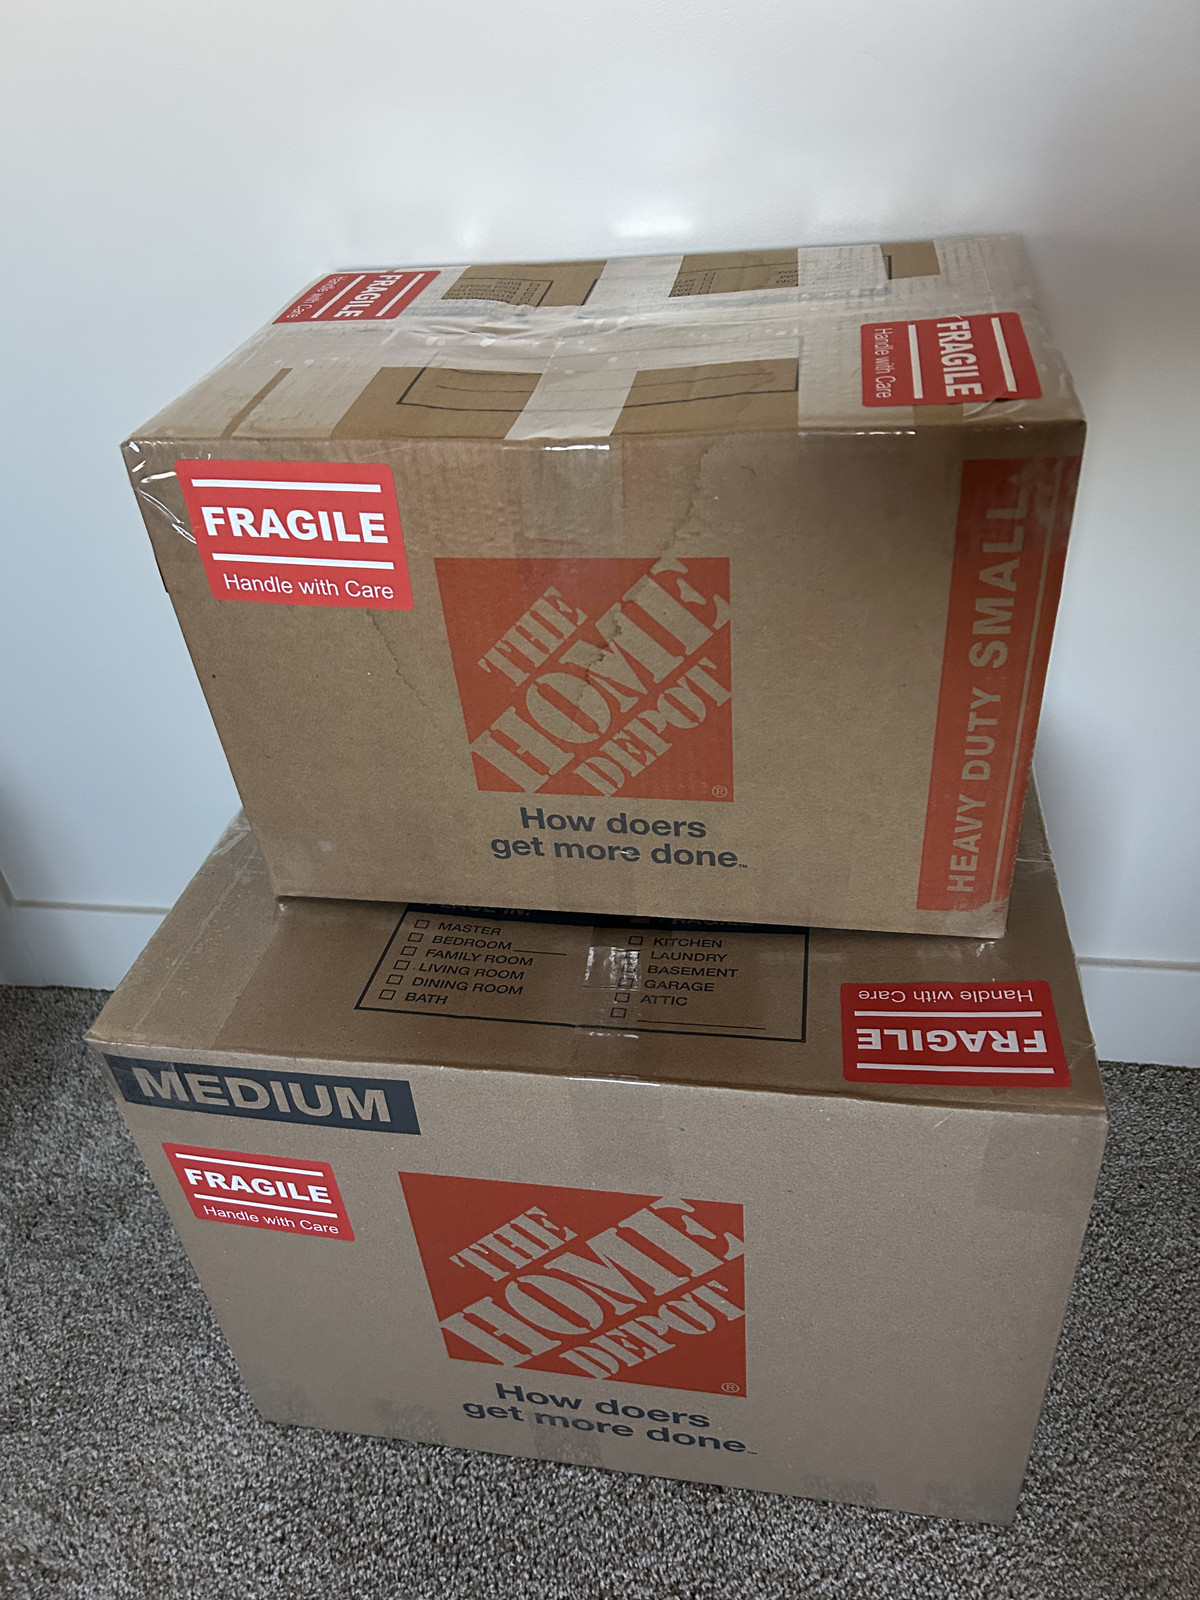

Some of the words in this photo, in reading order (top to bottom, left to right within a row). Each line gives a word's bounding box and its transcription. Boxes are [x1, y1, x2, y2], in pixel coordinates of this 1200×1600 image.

[333, 274, 403, 318] FRAGILE
[286, 303, 313, 318] Care
[874, 327, 894, 356] Handle
[875, 357, 896, 374] with
[936, 320, 983, 397] FRAGILE
[875, 375, 897, 398] Care
[201, 506, 389, 544] FRAGILE
[223, 573, 293, 594] Handle
[298, 578, 339, 597] with
[345, 580, 394, 600] Care
[968, 489, 1029, 669] SMALL
[477, 586, 588, 687] THE
[470, 556, 731, 793] HOME
[573, 658, 732, 797] DEPOT
[961, 687, 1002, 781] DUTY
[519, 806, 596, 832] How
[607, 812, 707, 839] doers
[490, 836, 545, 860] get
[554, 842, 641, 862] more
[946, 794, 987, 894] HEAVY
[432, 935, 512, 950] BEDROOM
[438, 922, 502, 936] MASTER
[653, 937, 723, 948] KITCHEN
[425, 948, 482, 962] FAMILY
[484, 954, 534, 966] ROOM
[650, 951, 728, 963] LAUNDRY
[418, 962, 470, 976] LIVING
[474, 968, 525, 980] ROOM
[647, 965, 739, 978] BASEMENT
[404, 992, 448, 1004] BATH
[412, 977, 469, 991] DINING
[472, 982, 523, 995] ROOM
[644, 979, 715, 992] GARAGE
[858, 990, 906, 1003] Care
[913, 990, 953, 1003] with
[960, 989, 1033, 1003] Handle
[640, 994, 688, 1006] ATTIC
[856, 1028, 1048, 1053] FRAGILE
[131, 1067, 391, 1123] MEDIUM
[184, 1168, 332, 1204] FRAGILE
[203, 1205, 259, 1223] Handle
[263, 1216, 295, 1228] with
[300, 1219, 339, 1234] Care
[449, 1206, 578, 1281] THE
[440, 1196, 745, 1367] HOME
[558, 1280, 746, 1380] DEPOT
[495, 1382, 582, 1410] How
[595, 1399, 710, 1428] doers
[463, 1402, 524, 1421] get
[535, 1412, 634, 1437] more
